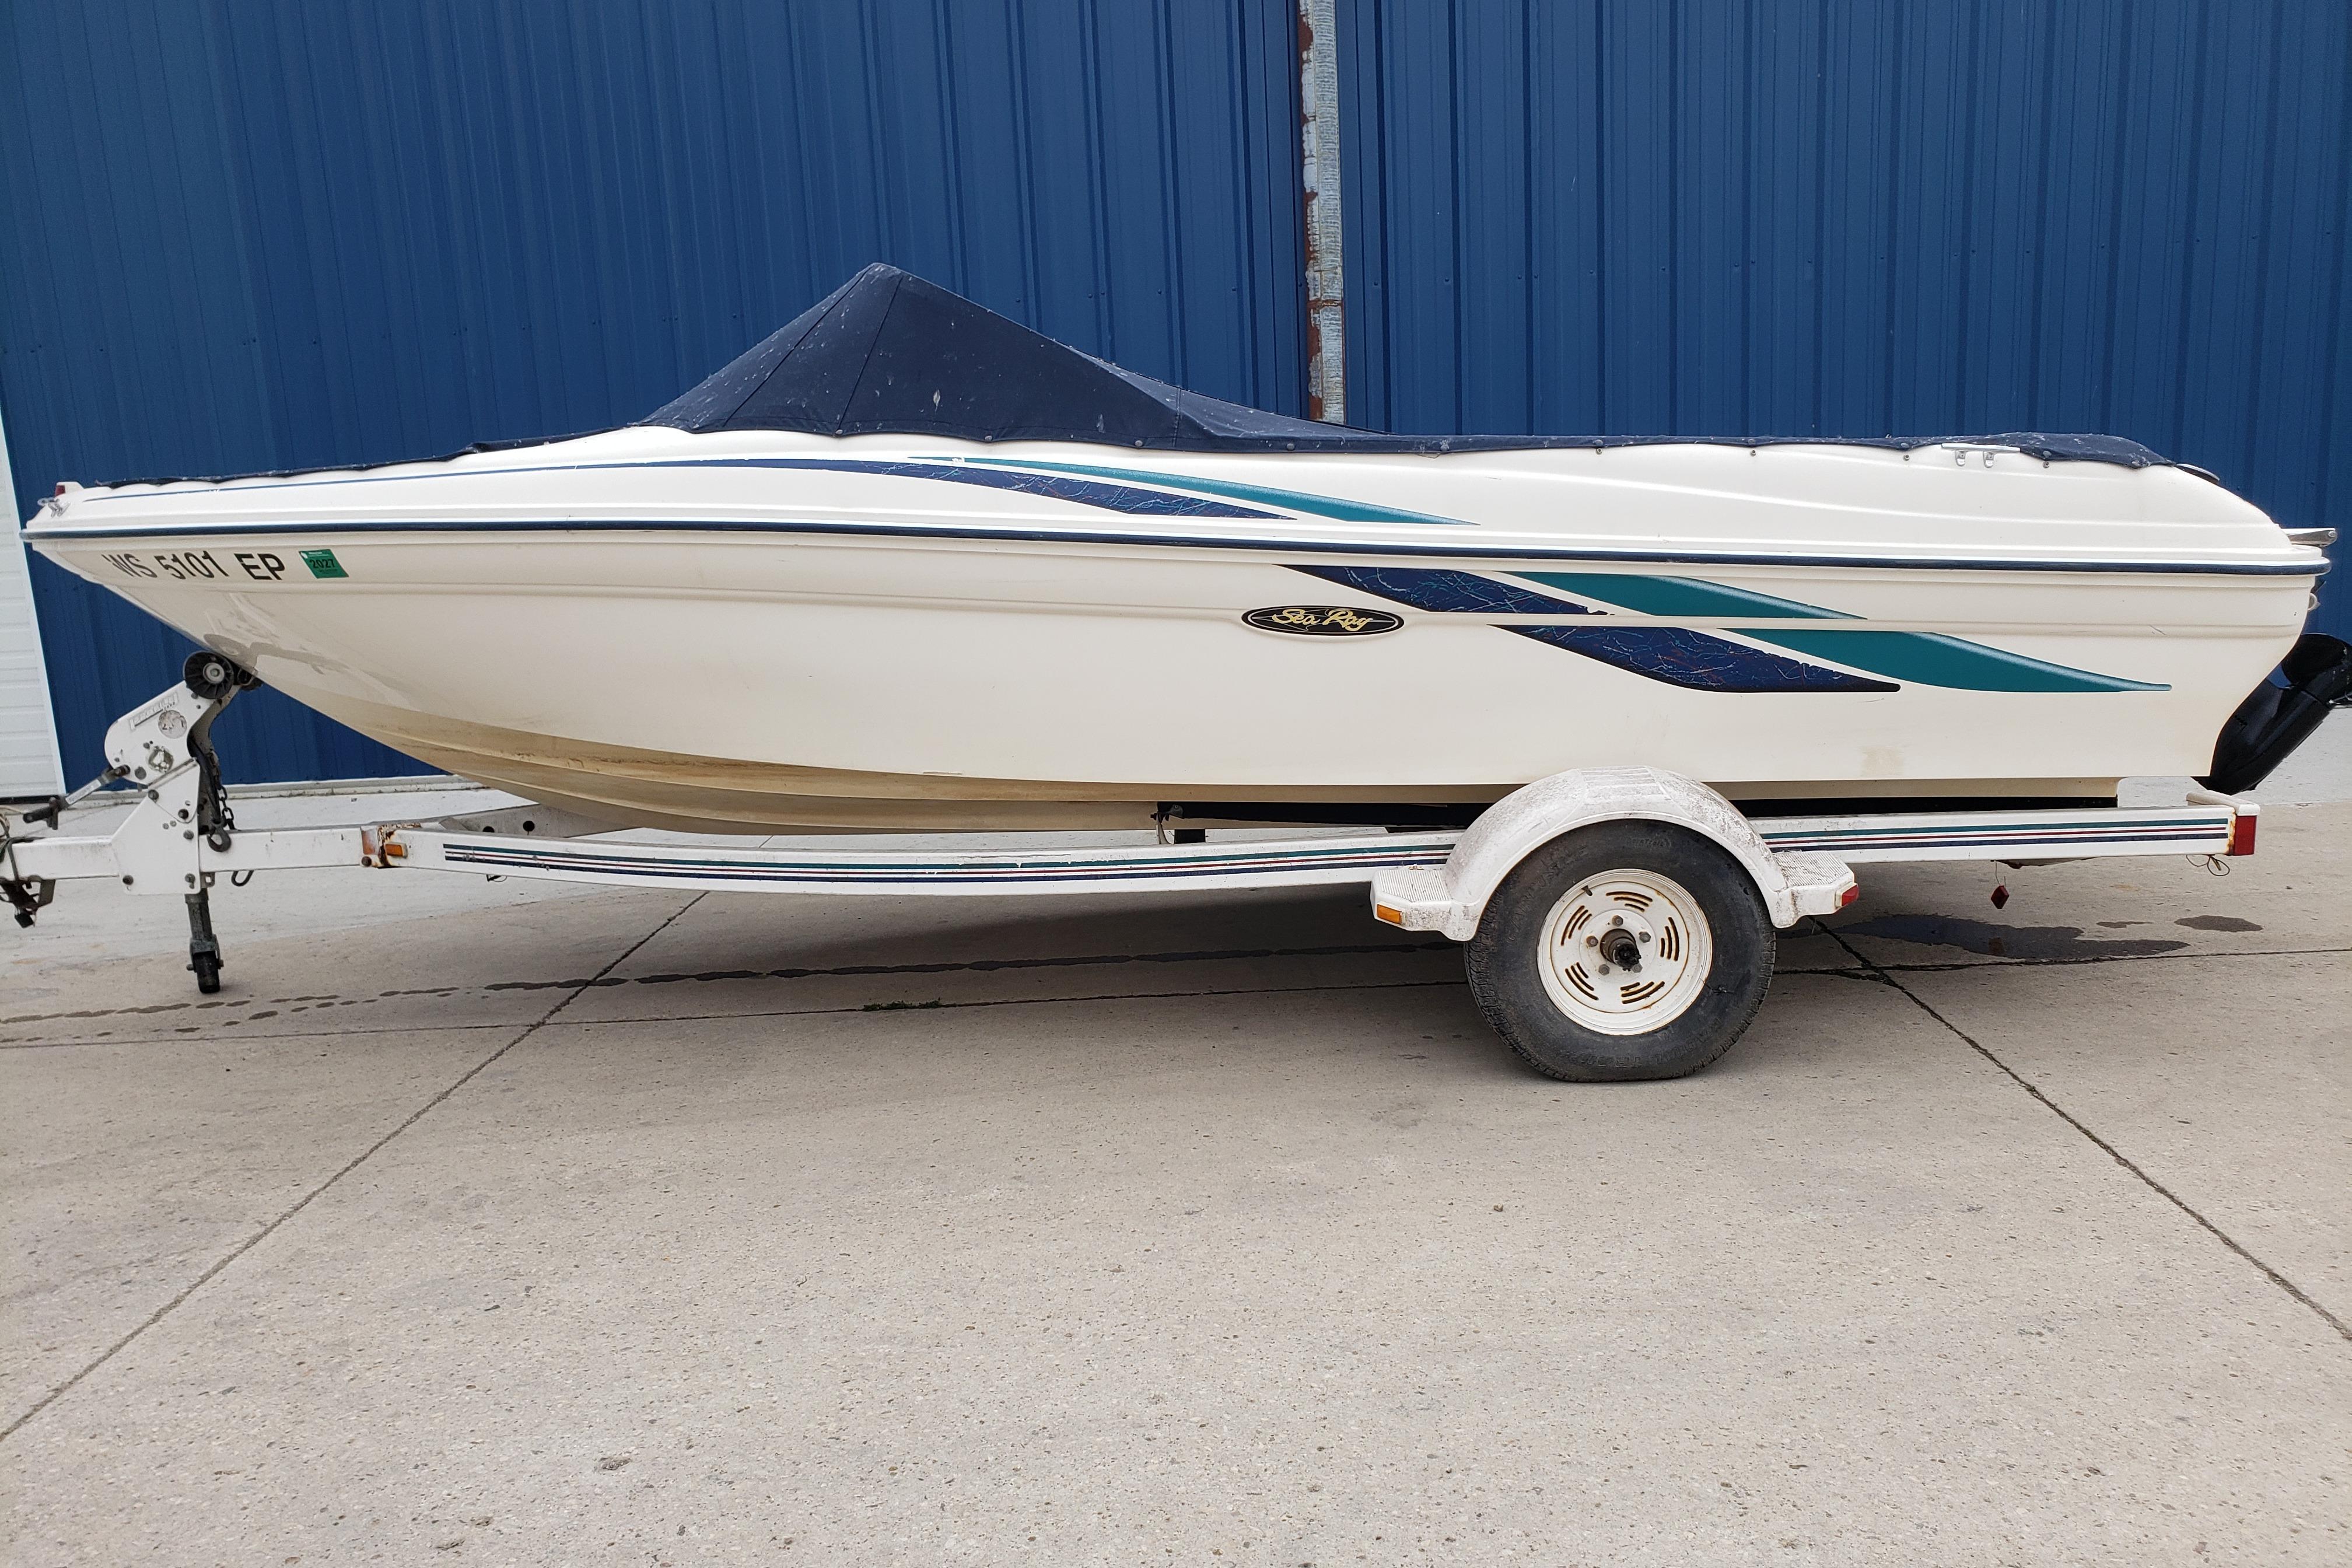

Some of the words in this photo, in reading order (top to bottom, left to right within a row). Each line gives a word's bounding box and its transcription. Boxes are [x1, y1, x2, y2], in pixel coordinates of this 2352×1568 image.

[101, 554, 158, 578] WS
[153, 550, 229, 580] 5101
[234, 553, 285, 580] EP
[309, 559, 335, 569] 2027
[1272, 608, 1321, 625] Sea
[1322, 608, 1373, 631] Ray
